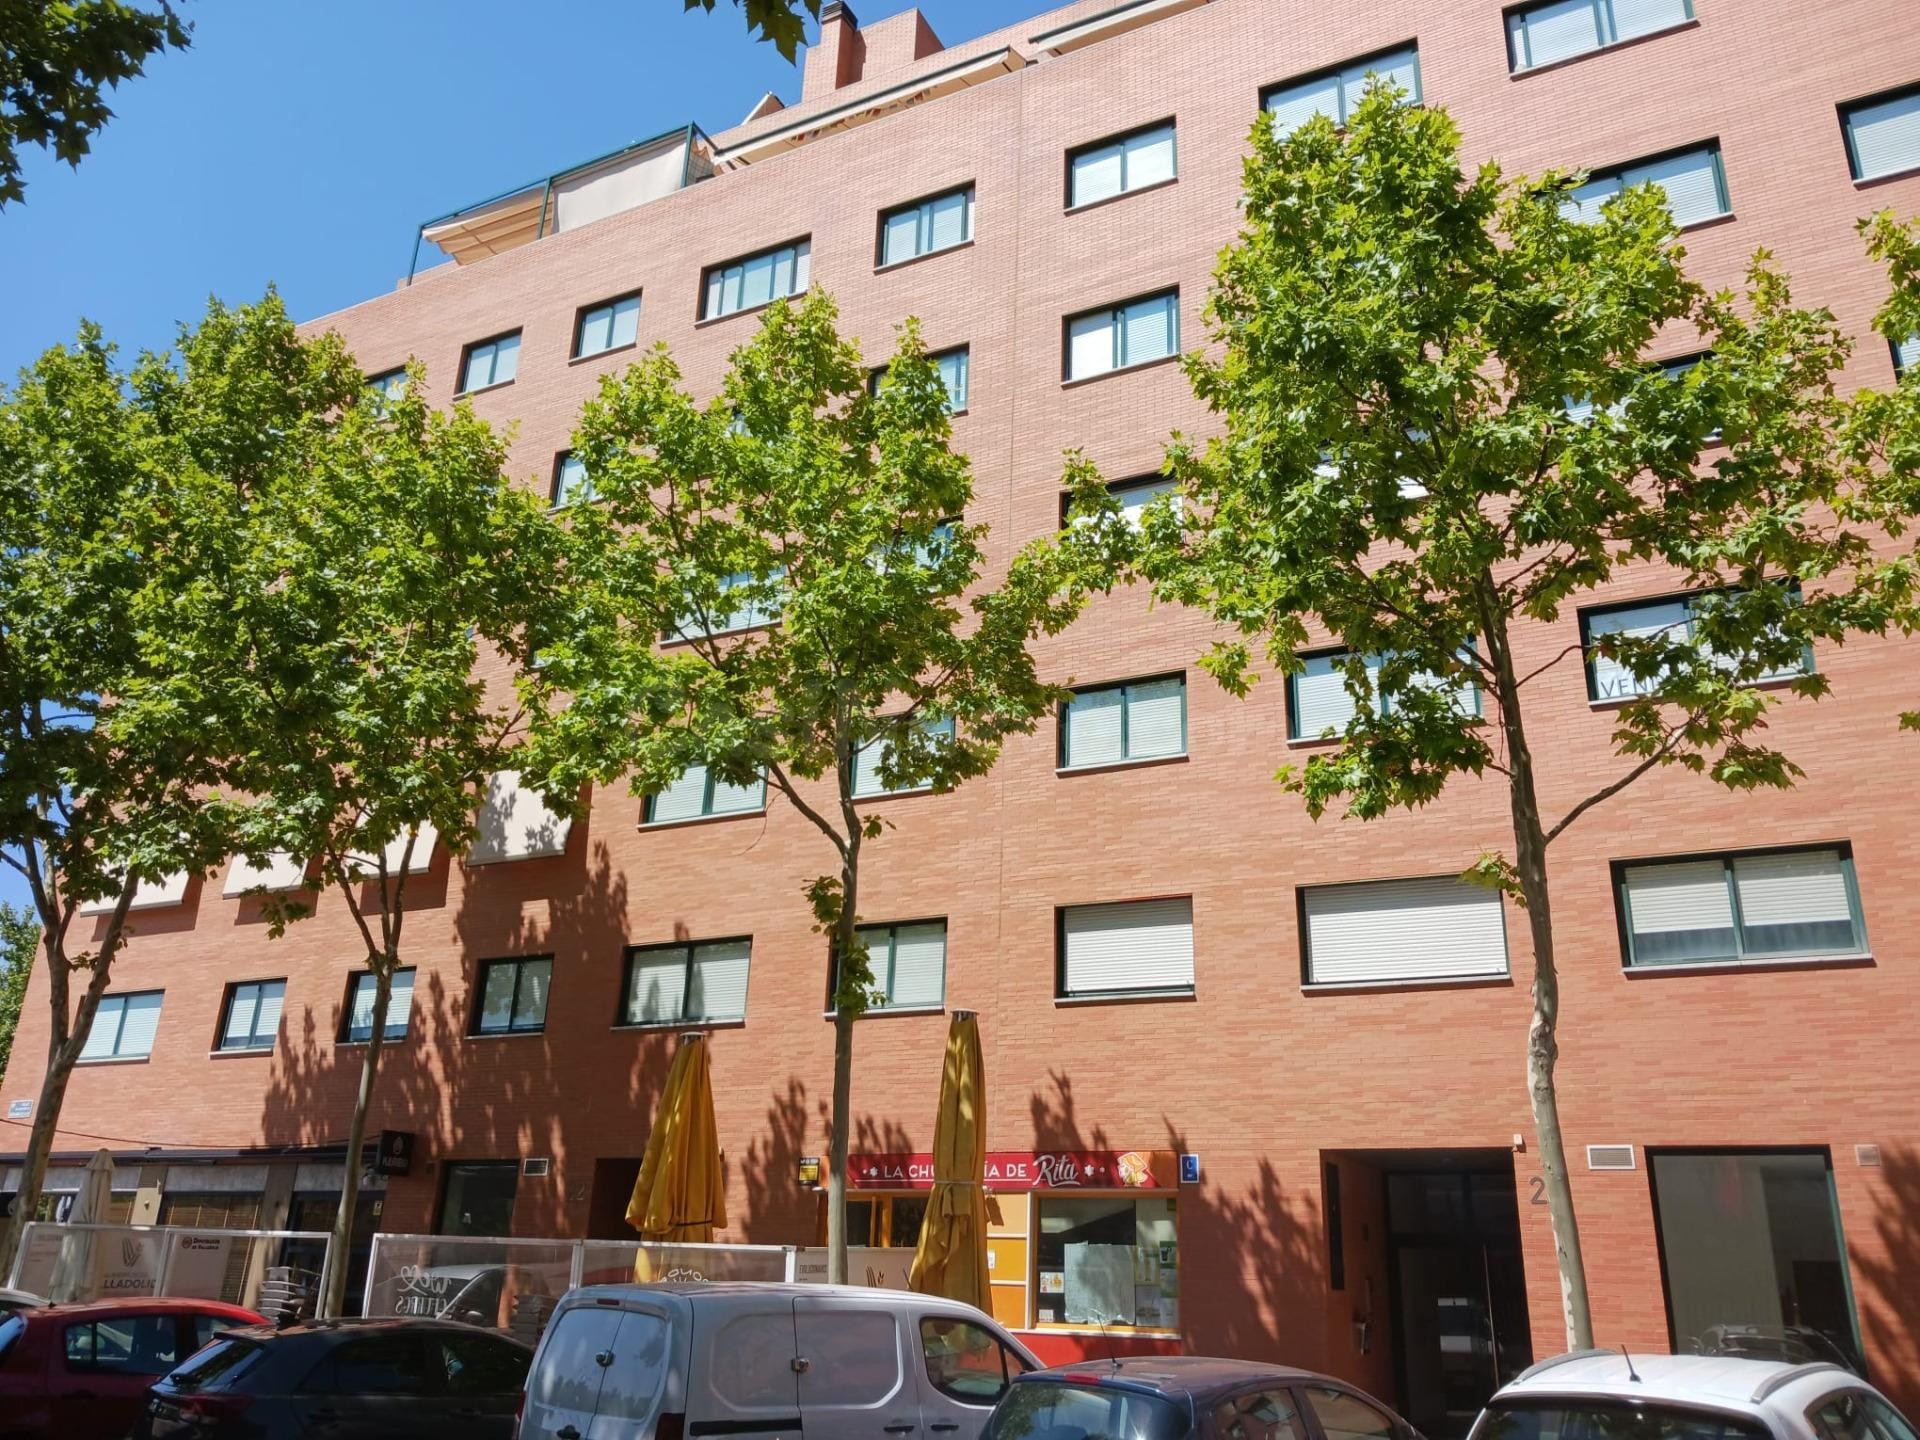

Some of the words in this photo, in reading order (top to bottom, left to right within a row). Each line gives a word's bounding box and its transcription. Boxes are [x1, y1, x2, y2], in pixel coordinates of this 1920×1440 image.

[884, 1165, 901, 1178] LA
[1006, 1163, 1027, 1177] DE
[1032, 1154, 1081, 1188] Rita
